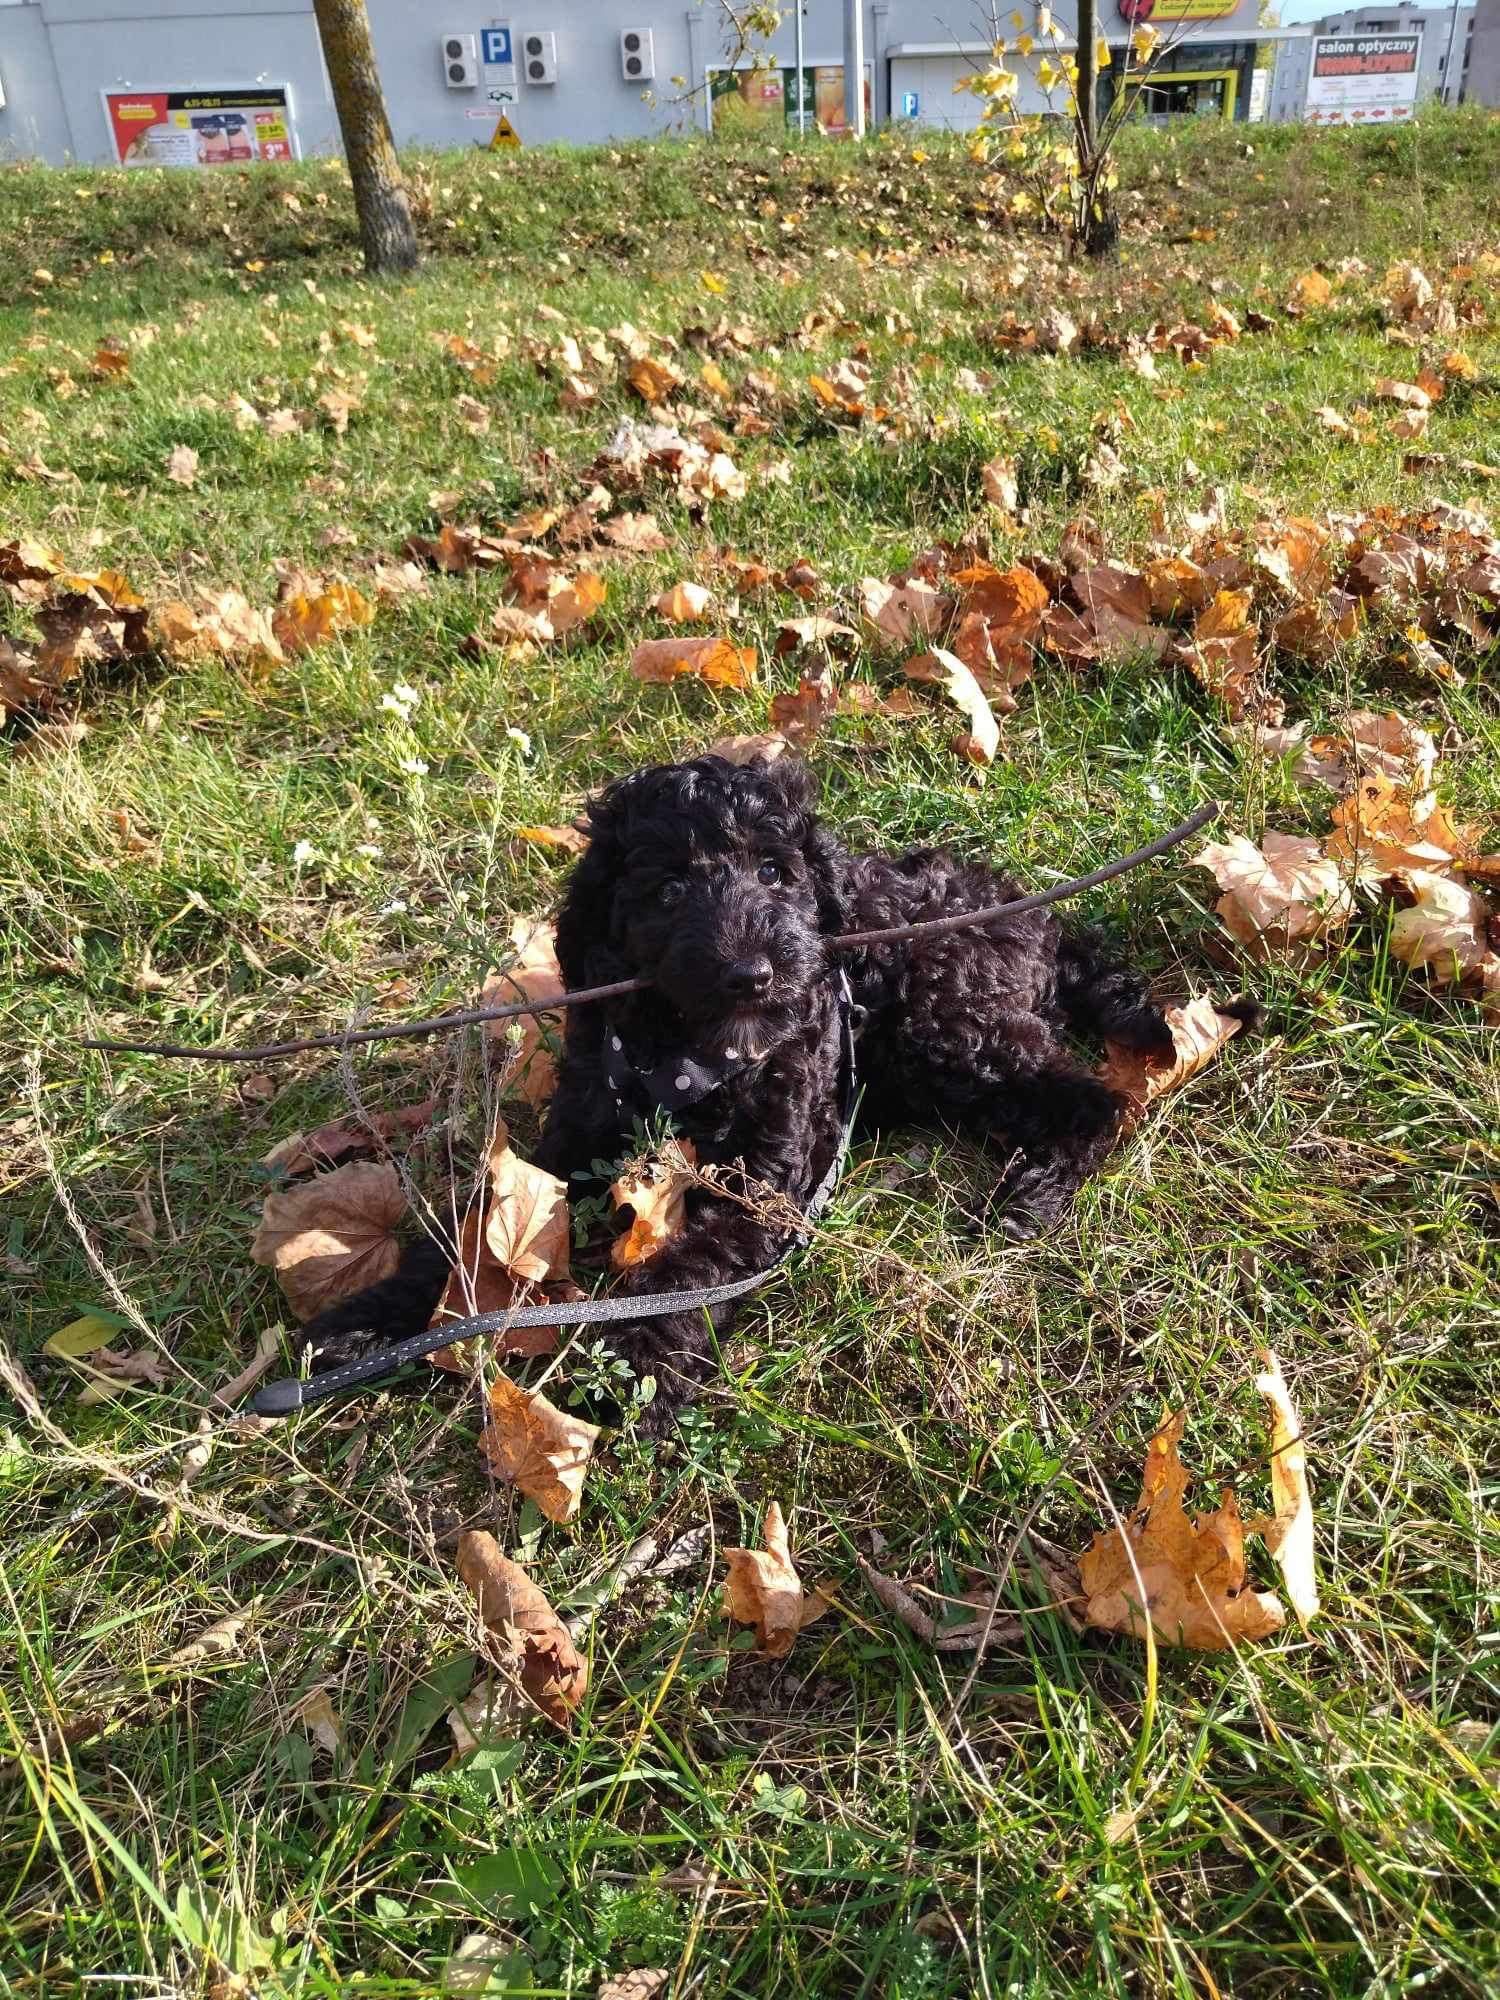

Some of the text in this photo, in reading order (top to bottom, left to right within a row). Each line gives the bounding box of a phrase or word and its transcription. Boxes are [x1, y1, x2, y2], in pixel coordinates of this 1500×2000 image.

[488, 33, 506, 61] P
[1318, 40, 1416, 54] salon optyczny
[905, 95, 916, 116] P
